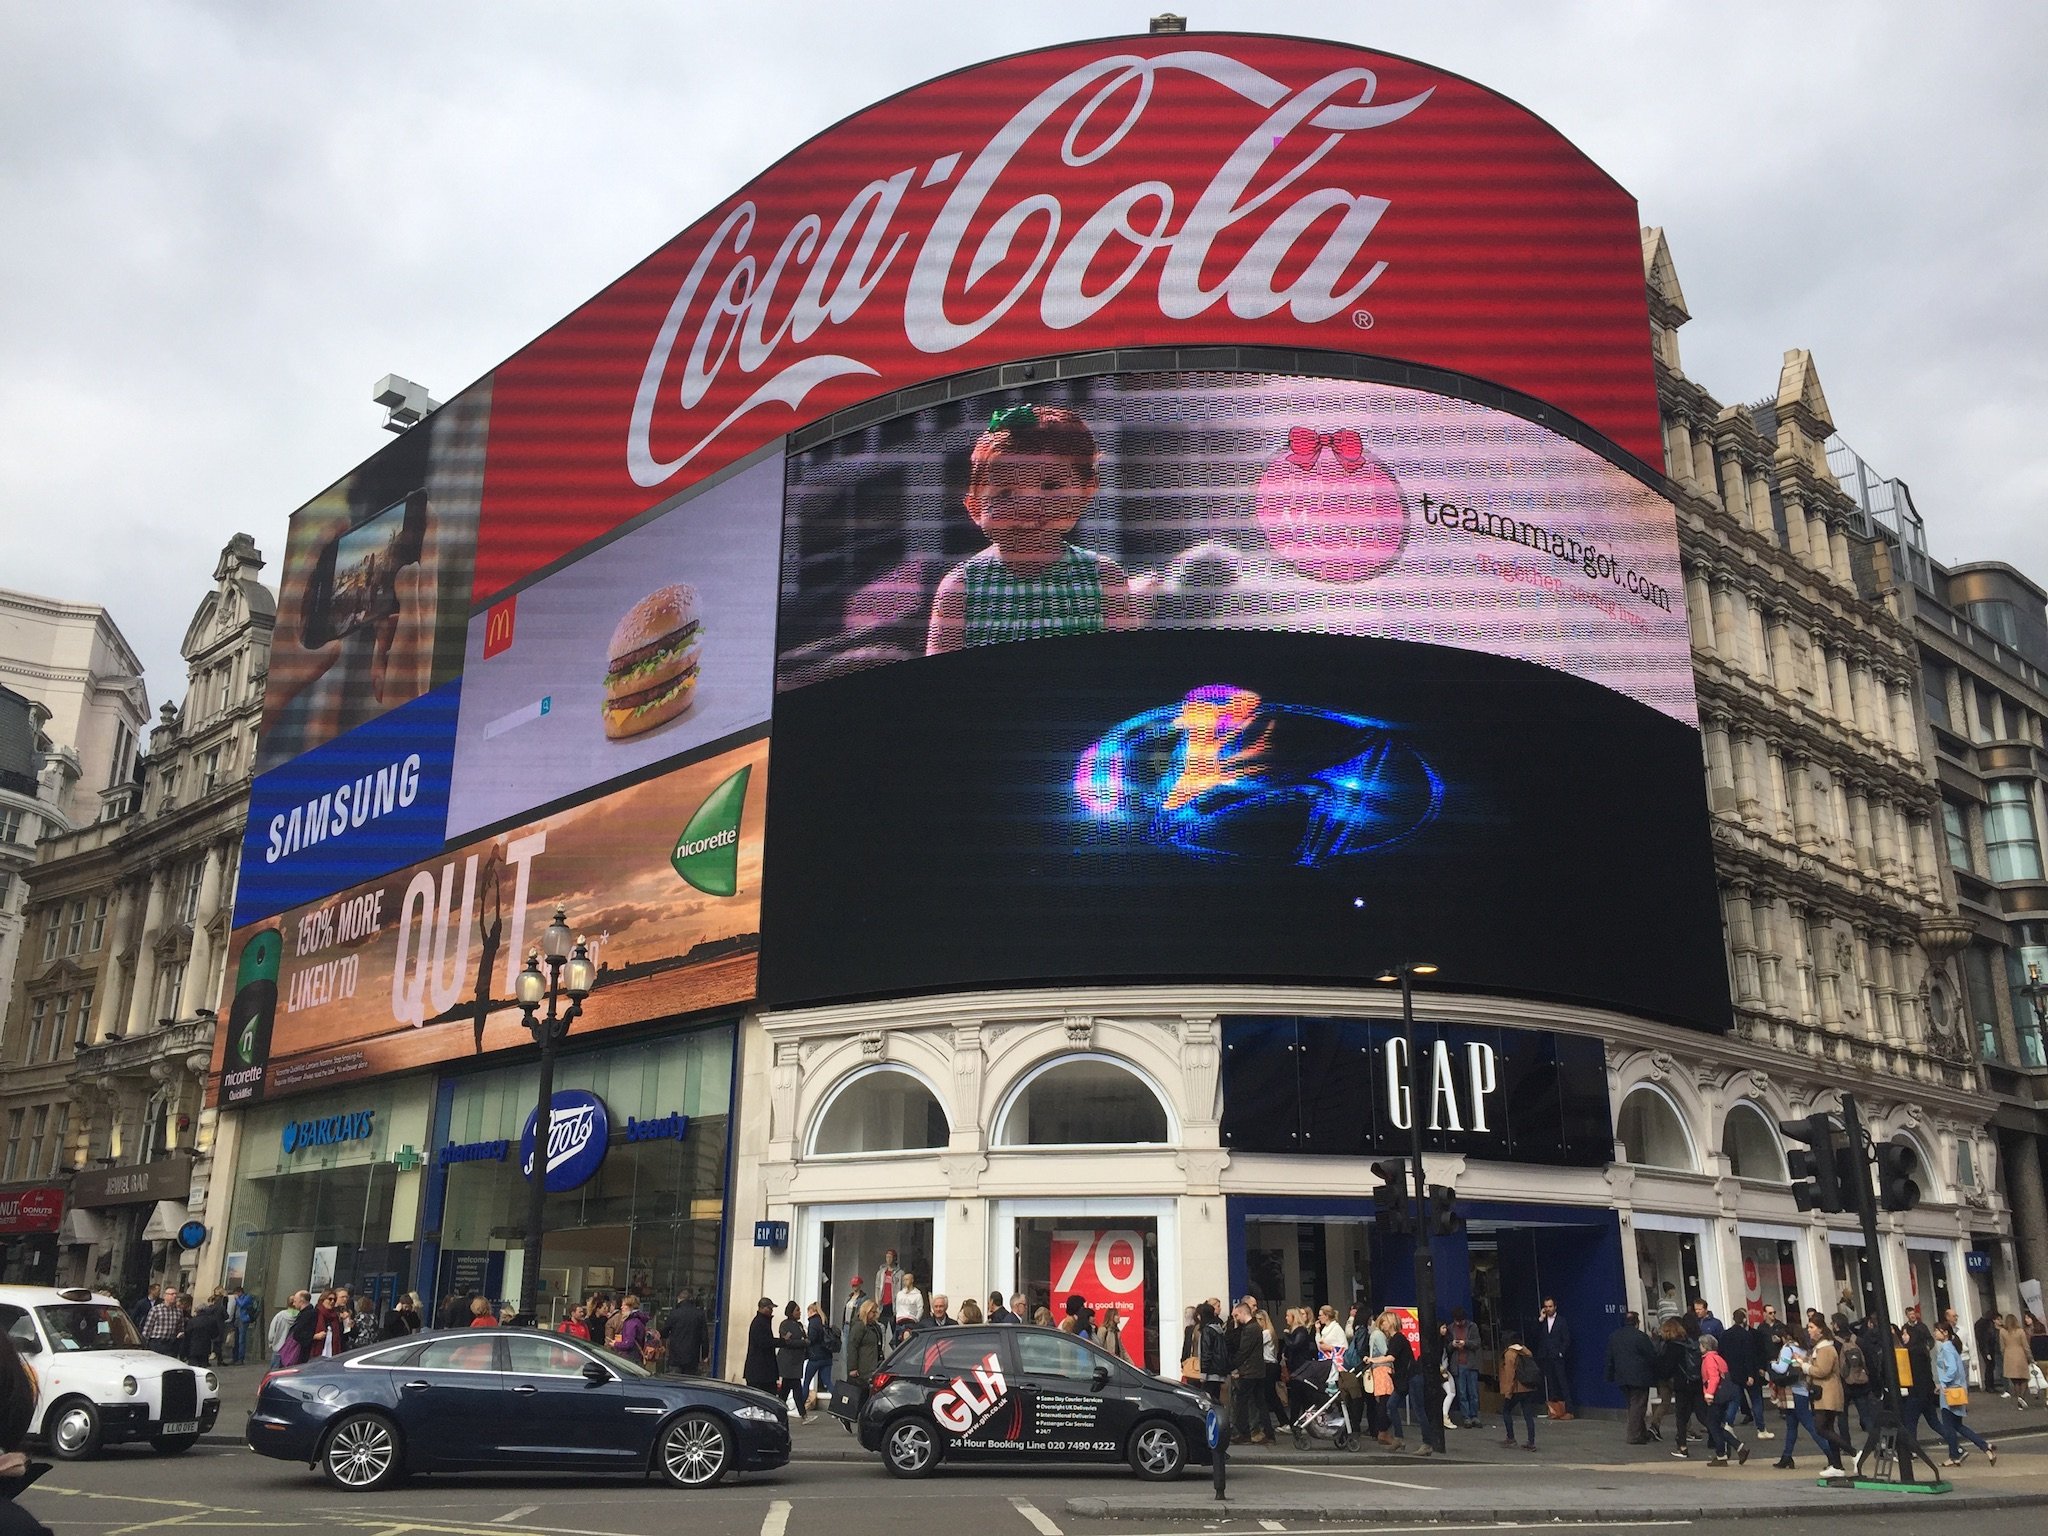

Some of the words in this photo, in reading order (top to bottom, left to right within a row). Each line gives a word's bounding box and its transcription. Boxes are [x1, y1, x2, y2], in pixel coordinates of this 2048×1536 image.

[627, 51, 1437, 487] Coca-Cola
[1420, 493, 1672, 614] teammargot.com
[266, 753, 421, 864] SAMSUNG
[676, 827, 737, 859] nicorette
[295, 906, 335, 957] 150%
[336, 888, 385, 945] MORE
[288, 959, 340, 1013] LIKELY
[339, 954, 360, 1000] TO
[224, 1066, 263, 1086] nicorette
[1385, 1037, 1496, 1133] GAP
[299, 1110, 374, 1149] BARCLAYS
[626, 1111, 690, 1142] beauty
[438, 1139, 510, 1169] pharmacy
[105, 1175, 129, 1196] JEWEL
[130, 1172, 149, 1193] BAR
[757, 1227, 770, 1240] GAP
[775, 1227, 787, 1240] GAP
[457, 1255, 490, 1264] welcome
[1052, 1230, 1144, 1294] 70
[1113, 1256, 1121, 1265] UP
[1121, 1256, 1131, 1265] TO
[1969, 1256, 1982, 1267] GAP
[1095, 1302, 1114, 1310] good
[1115, 1301, 1134, 1310] thing
[932, 1351, 1008, 1432] GLH
[961, 1397, 1008, 1440] www.glh.co.uk
[950, 1439, 962, 1448] 24
[963, 1439, 986, 1448] Hour
[988, 1440, 1025, 1451] Booking
[1026, 1440, 1046, 1449] Line
[1047, 1441, 1065, 1450] 020
[1067, 1441, 1091, 1450] 7490
[1092, 1442, 1116, 1451] 4222
